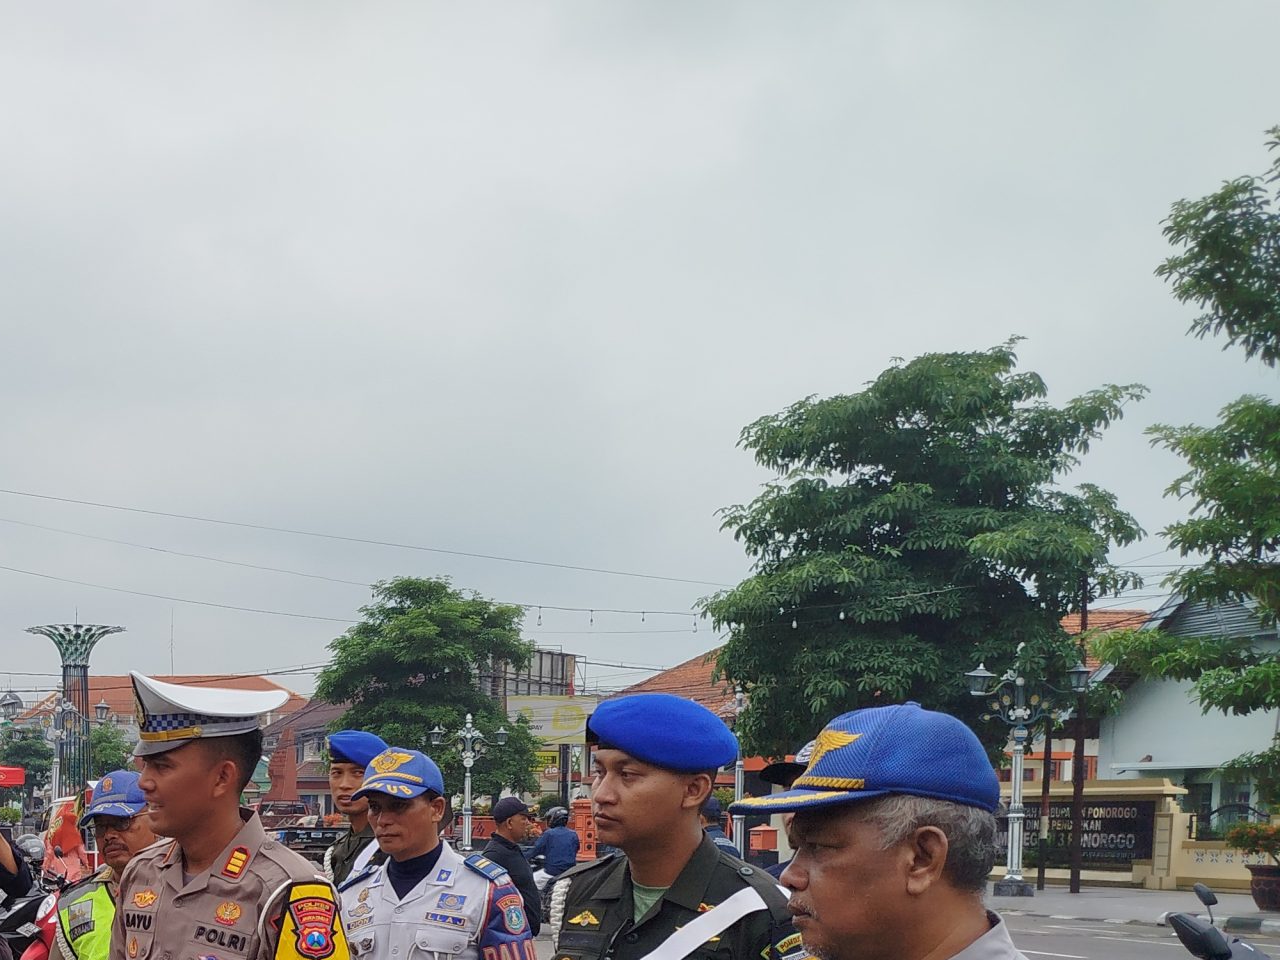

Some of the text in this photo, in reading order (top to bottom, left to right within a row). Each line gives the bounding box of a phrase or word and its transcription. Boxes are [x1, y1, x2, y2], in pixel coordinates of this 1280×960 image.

[1087, 807, 1138, 818] PONOROGO
[1067, 833, 1136, 849] PNOROGO
[126, 913, 152, 930] BAYU
[195, 926, 247, 951] POLRI
